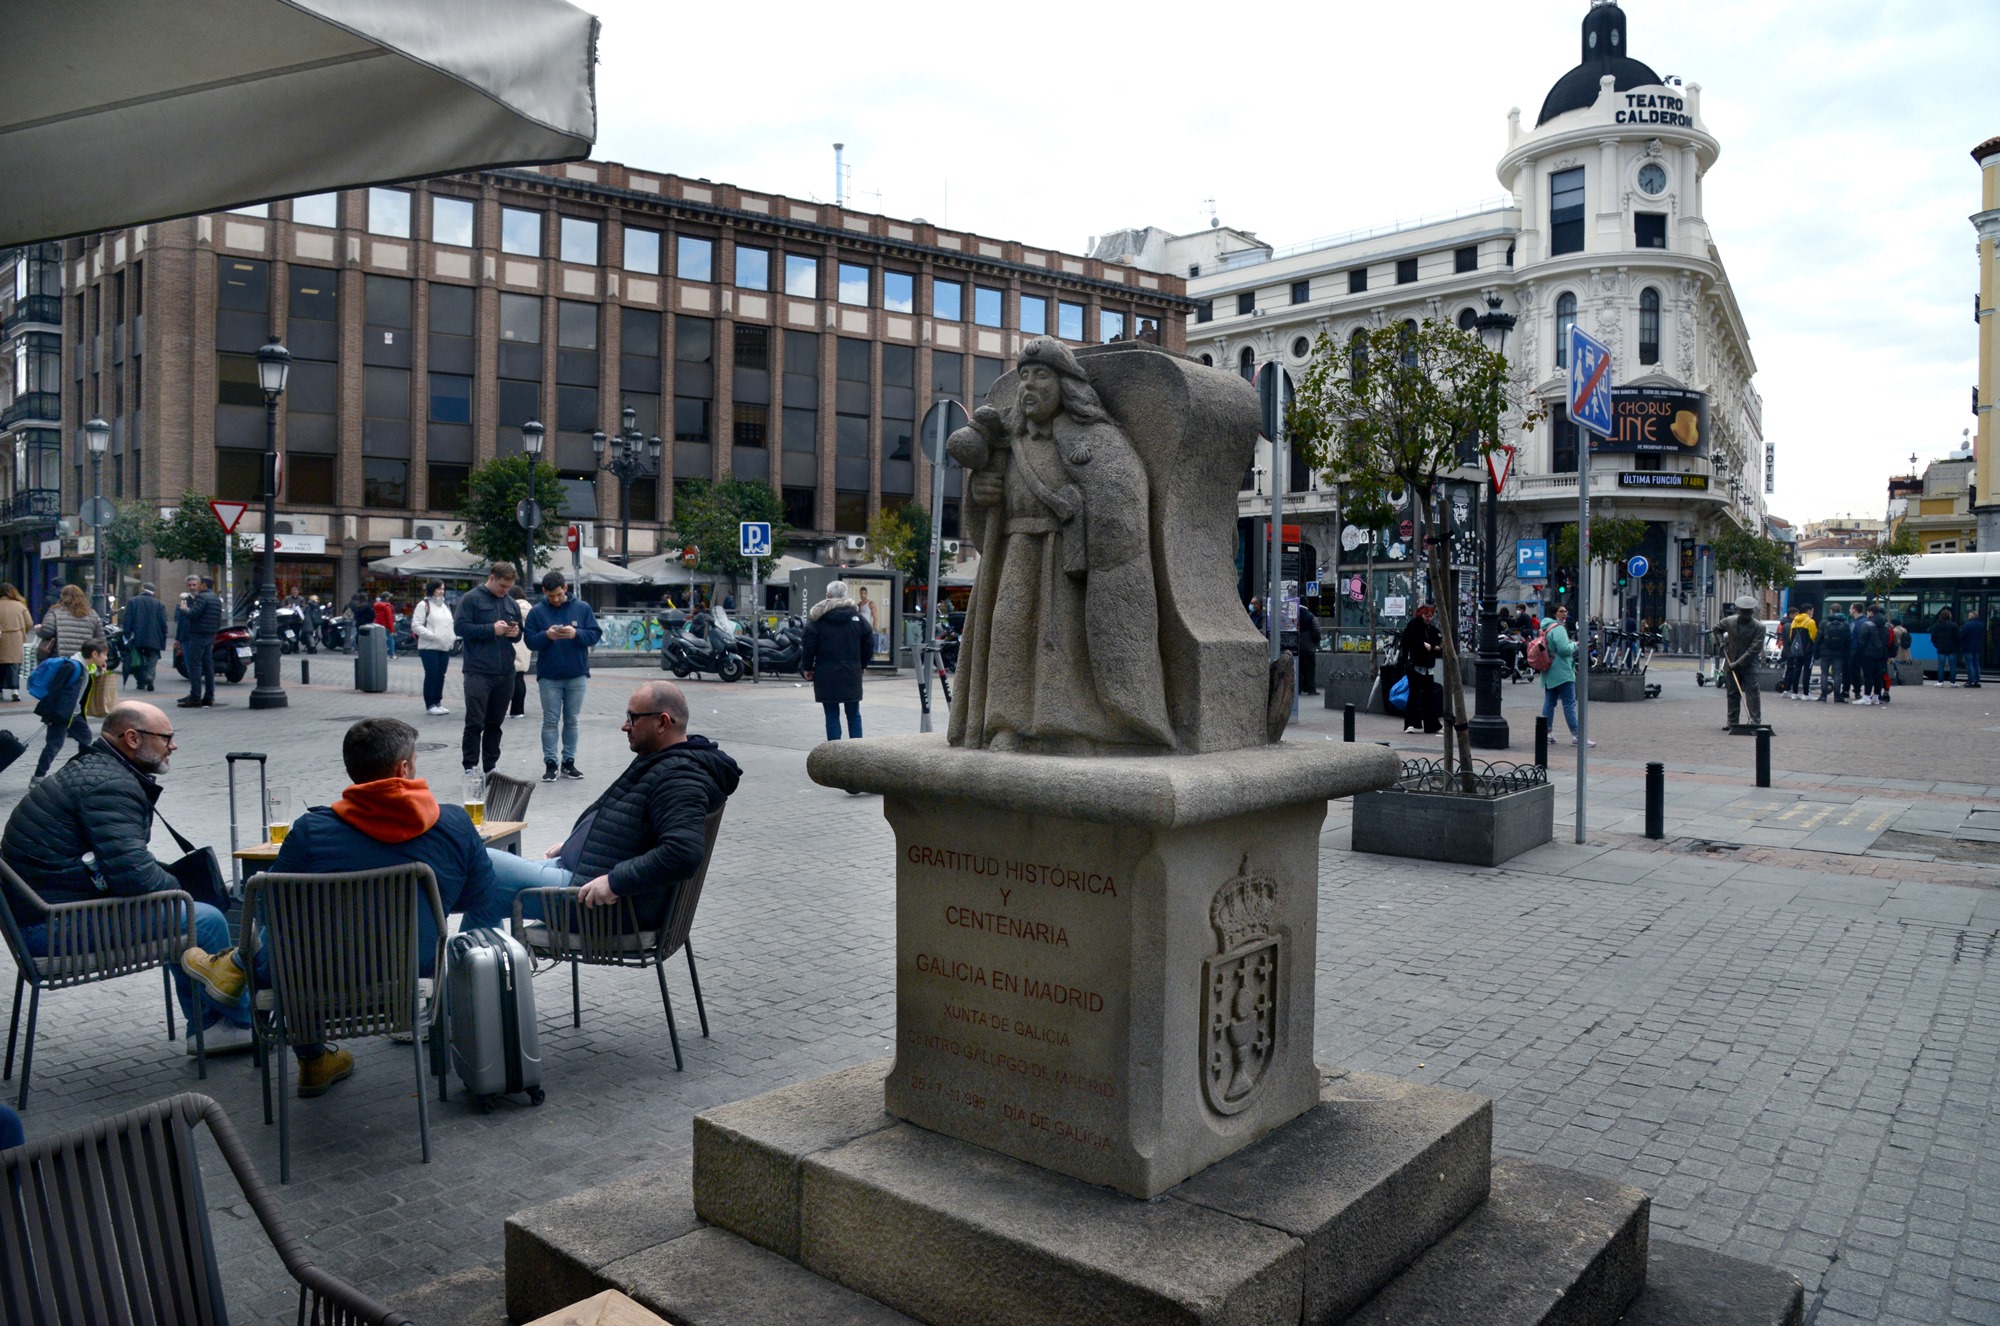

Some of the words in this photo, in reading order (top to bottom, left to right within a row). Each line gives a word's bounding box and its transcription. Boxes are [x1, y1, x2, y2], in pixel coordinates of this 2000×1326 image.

[1615, 110, 1693, 128] CALDERON
[1625, 94, 1683, 111] TEATRO
[1618, 402, 1671, 415] CHORUS
[1623, 473, 1650, 484] ÚLTIMA
[1652, 474, 1682, 485] FUNCIÓN
[1683, 476, 1689, 485] 17
[1689, 477, 1705, 486] ABRIL
[1766, 445, 1774, 492] HOTEL
[1519, 548, 1532, 564] P
[908, 845, 999, 876] GRATITUD
[1006, 860, 1117, 898] HISTÓRICA
[1000, 887, 1011, 907] Y
[946, 906, 1069, 948] CENTENARIA
[916, 953, 987, 986] GALICIA
[992, 970, 1018, 993] EN
[1024, 977, 1104, 1013] MADRID
[943, 1002, 988, 1027] XUNTA
[991, 1015, 1009, 1032] DE
[1014, 1021, 1070, 1047] GALICIA
[908, 1029, 960, 1055] CENTRO
[963, 1044, 1028, 1075] GALLEGO
[1031, 1063, 1051, 1081] DE
[1056, 1070, 1115, 1099] MADRID
[1030, 1112, 1050, 1131] DE
[1054, 1120, 1111, 1149] GALICIA
